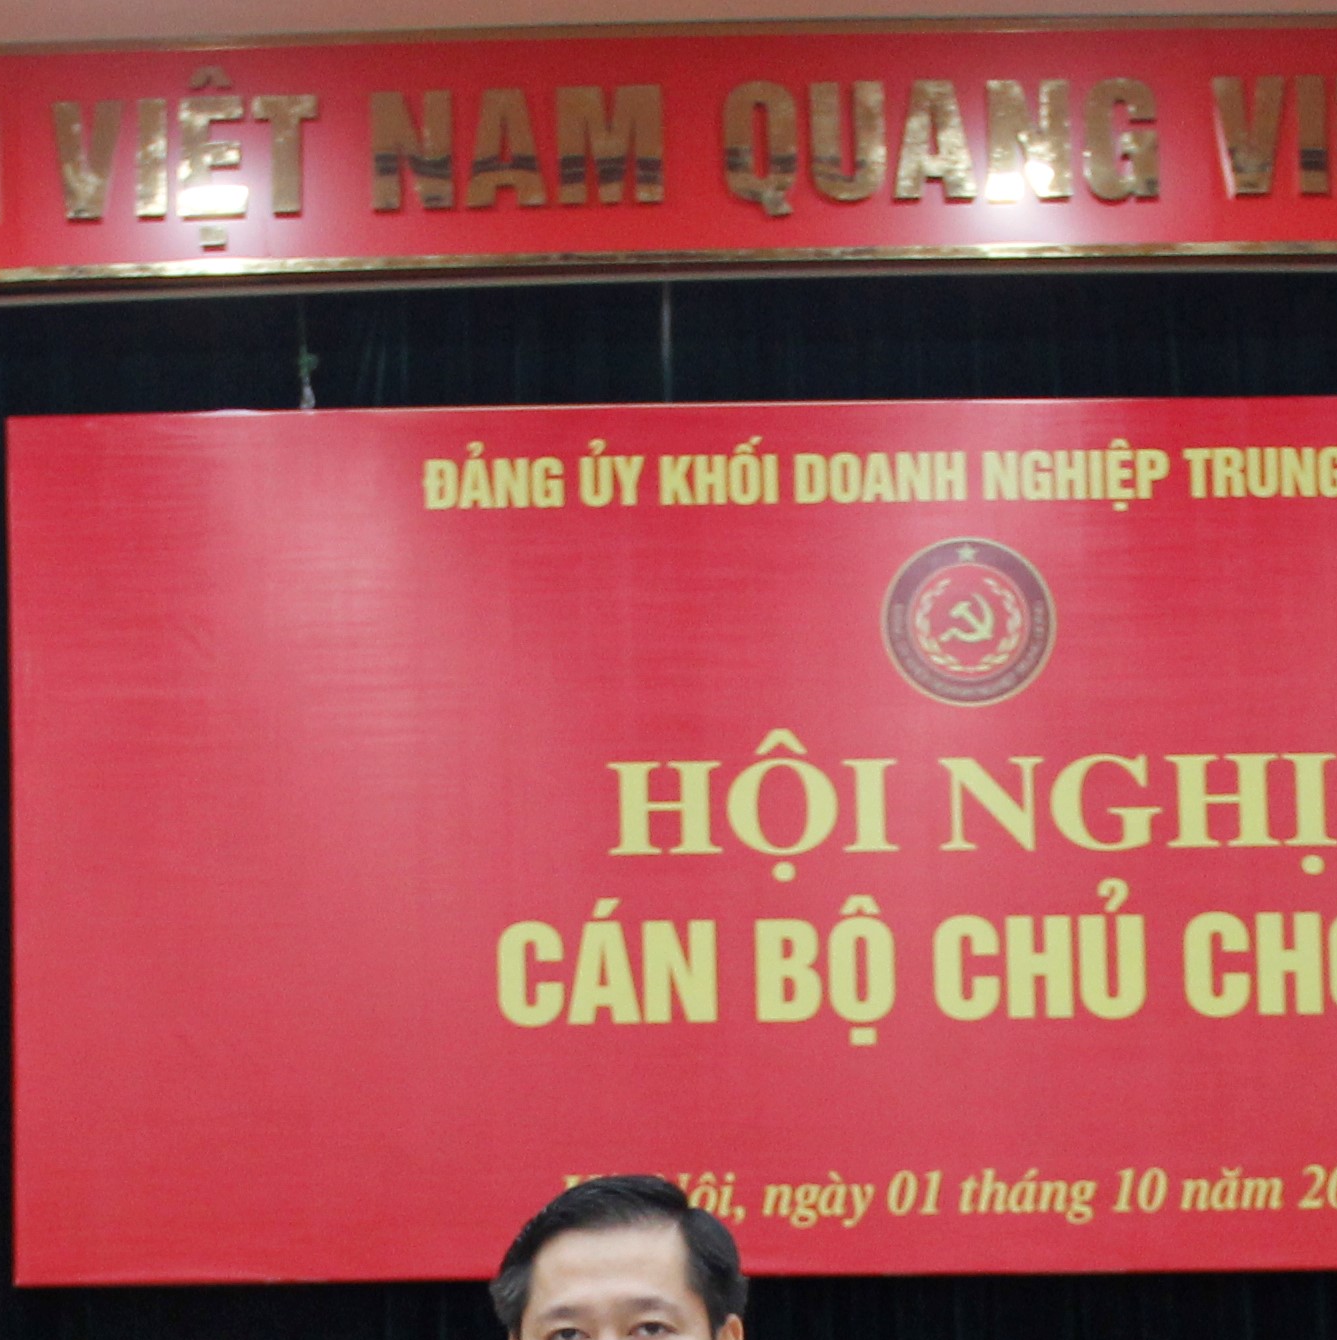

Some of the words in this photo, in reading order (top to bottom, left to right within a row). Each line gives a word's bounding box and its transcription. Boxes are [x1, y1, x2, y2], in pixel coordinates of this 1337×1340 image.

[51, 66, 319, 248] VIỆT
[369, 84, 664, 211] NAM
[722, 79, 1161, 217] QUANG
[422, 440, 564, 510] ĐẢNG
[578, 438, 645, 508] ỦY
[659, 435, 780, 507] KHỐI
[793, 451, 969, 504] DOANH
[981, 438, 1170, 512] NGHIỆP
[606, 728, 900, 882] HỘI
[495, 898, 718, 1027] CÁN
[754, 894, 896, 1046] BỘ
[932, 877, 1147, 1022] CHỦ
[762, 1174, 874, 1228] ngày
[886, 1171, 942, 1216] 01
[958, 1168, 1097, 1224] tháng
[1113, 1167, 1168, 1213] 10
[1180, 1167, 1284, 1211] năm
